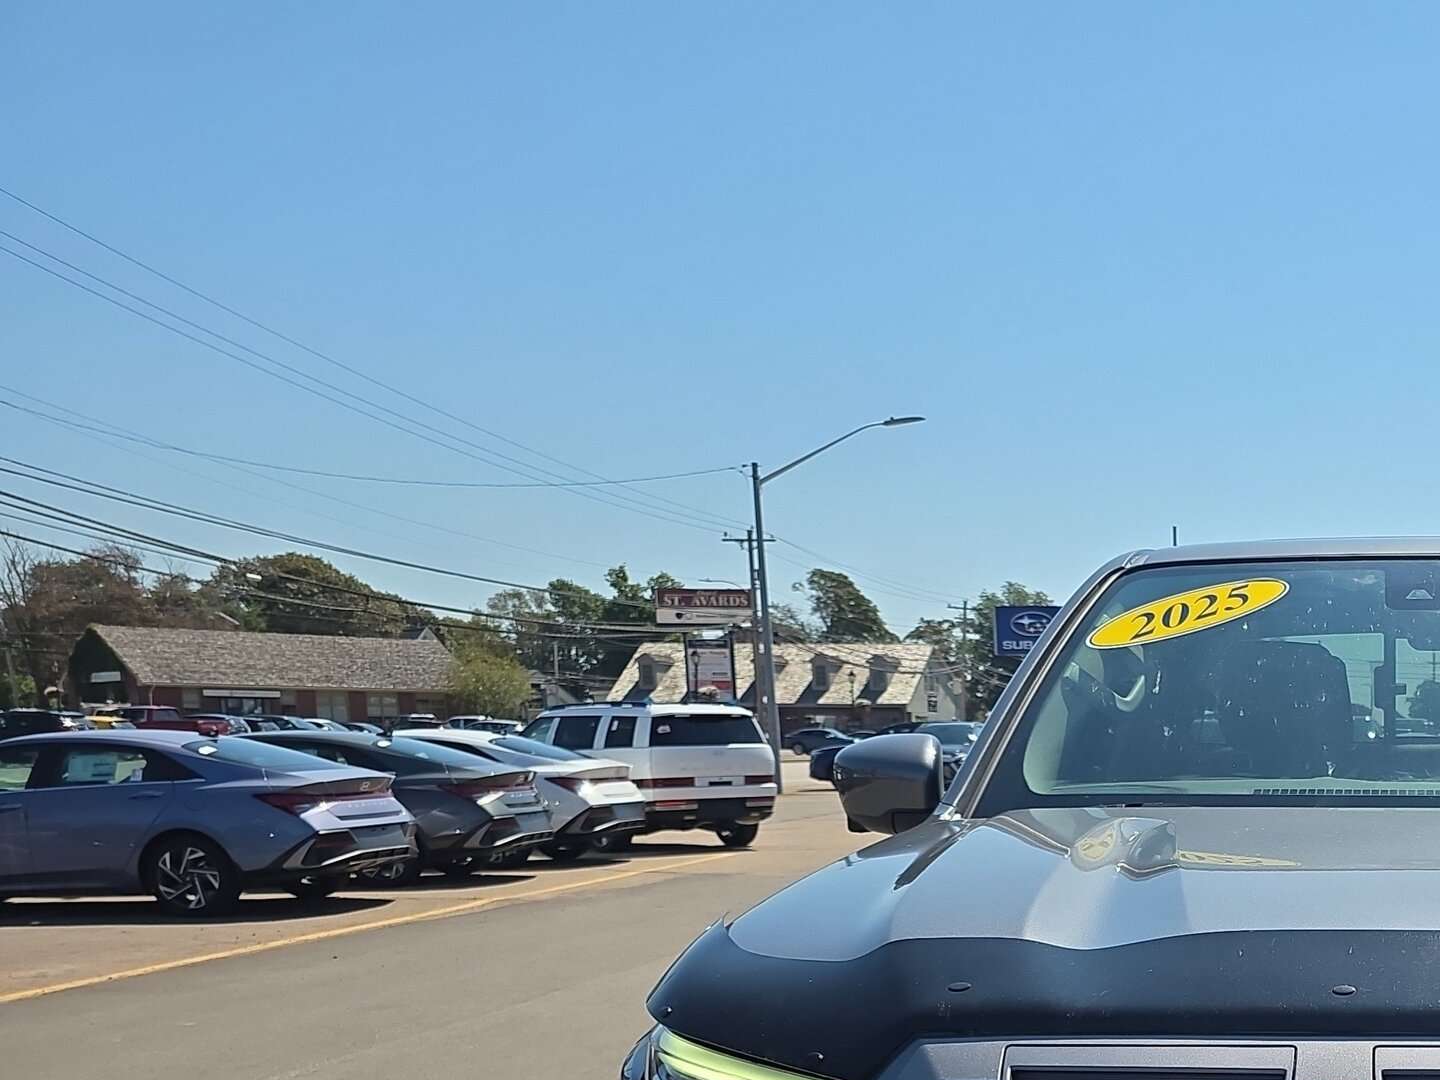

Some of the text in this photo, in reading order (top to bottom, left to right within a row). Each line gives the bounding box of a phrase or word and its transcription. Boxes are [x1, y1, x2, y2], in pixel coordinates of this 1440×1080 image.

[664, 596, 748, 606] ST. AVARDS
[1129, 584, 1250, 641] 2025
